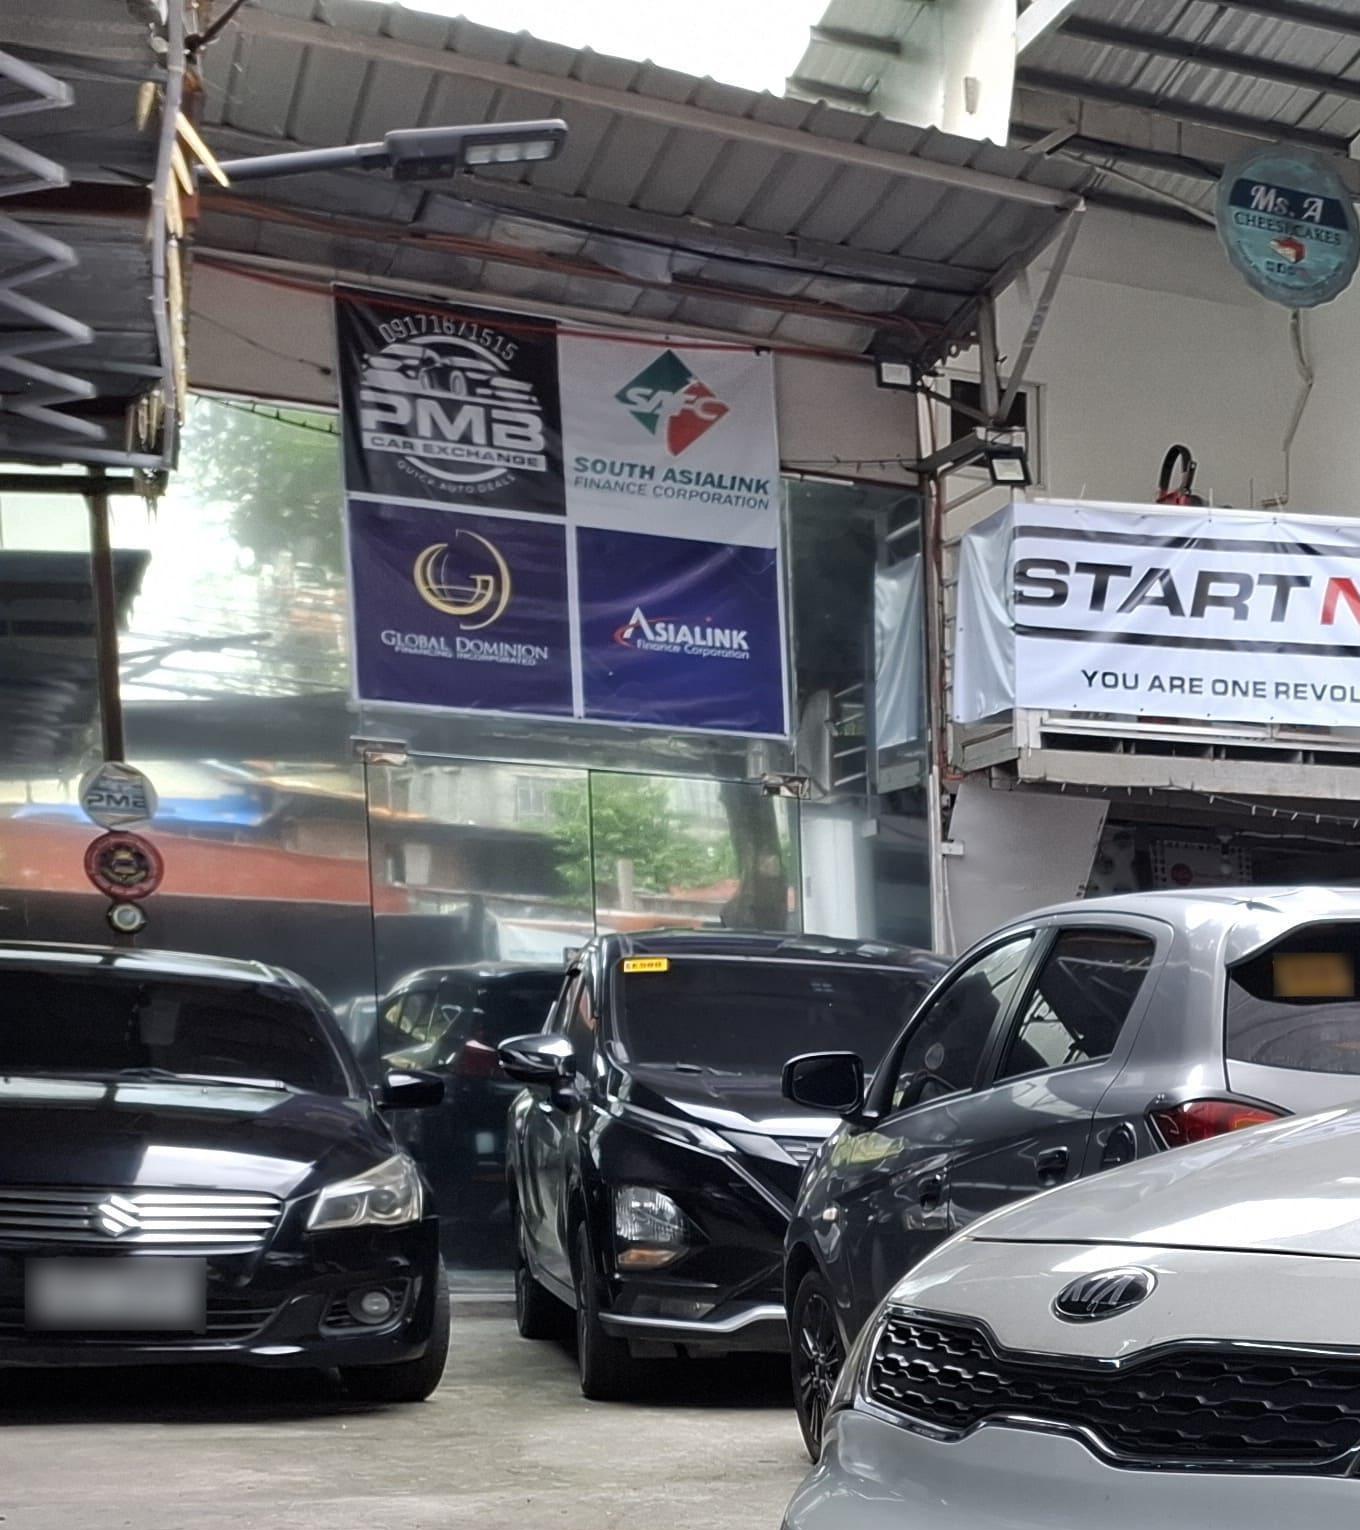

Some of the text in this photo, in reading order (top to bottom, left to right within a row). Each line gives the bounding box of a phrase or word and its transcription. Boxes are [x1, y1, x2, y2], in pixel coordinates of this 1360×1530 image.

[1250, 184, 1325, 224] Ms. A
[359, 389, 546, 452] PMB
[370, 435, 540, 468] CAR EXCHANGE
[573, 456, 772, 496] SOUTH ASIALINK
[573, 476, 770, 511] FINANCE CORPORATION
[1013, 556, 1312, 627] START
[380, 630, 549, 660] GLOBAL DOMINION
[1081, 668, 1140, 695] YOU
[1146, 671, 1204, 697] ARE
[1210, 677, 1268, 699] ONE
